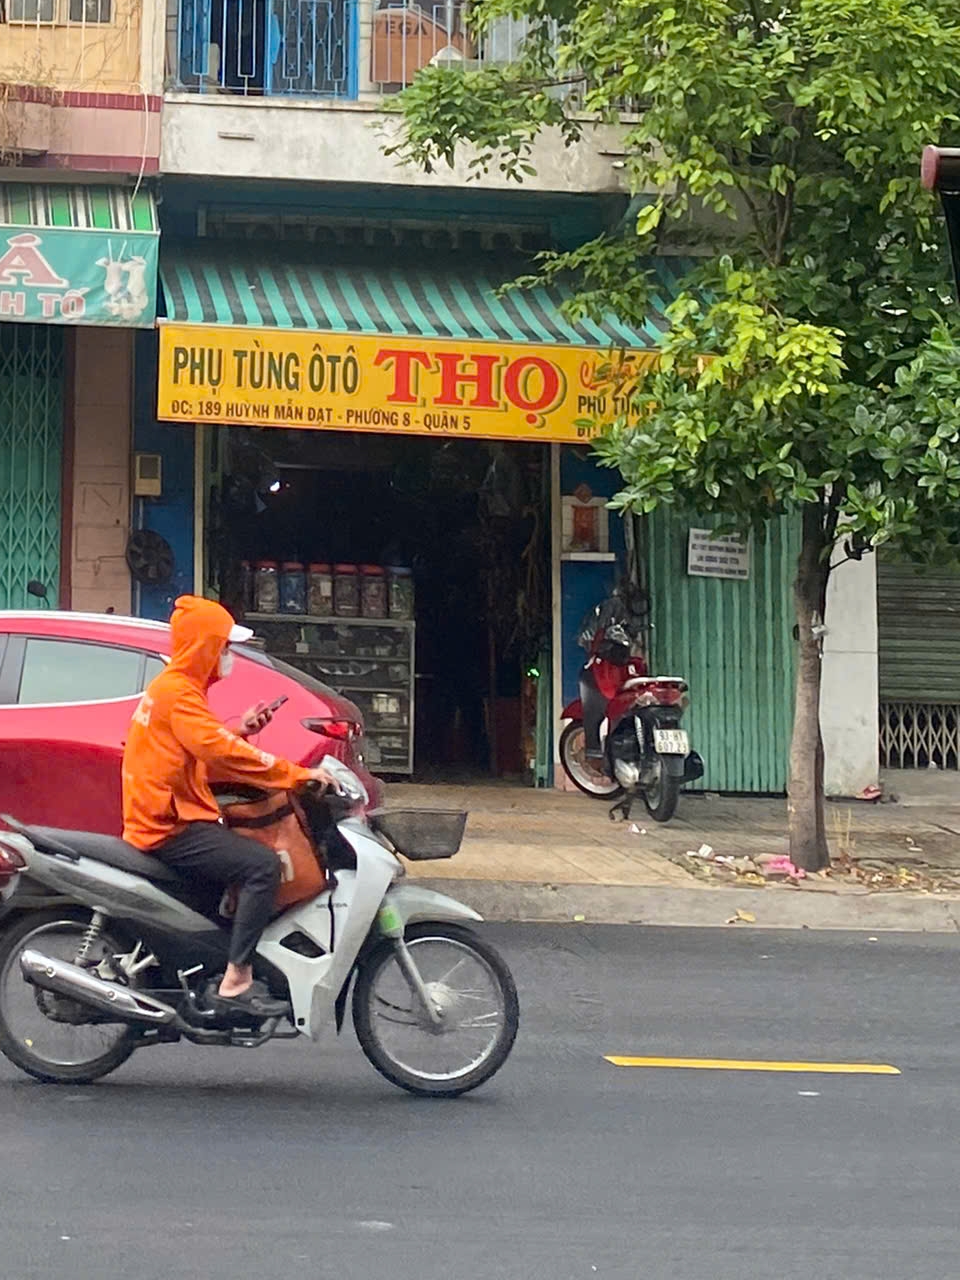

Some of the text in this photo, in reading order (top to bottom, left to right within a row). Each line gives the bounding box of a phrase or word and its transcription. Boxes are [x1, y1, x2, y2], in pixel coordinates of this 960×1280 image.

[37, 286, 90, 319] TỐ
[173, 346, 223, 395] PHỤ
[233, 340, 300, 391] TÙNG
[308, 344, 359, 394] ÔTÔ
[373, 349, 564, 426] THỌ
[198, 400, 221, 416] 189
[225, 400, 270, 419] HUỲNH
[346, 408, 399, 426] PHƯỜNG
[402, 412, 411, 427] 8
[463, 415, 471, 431] 5
